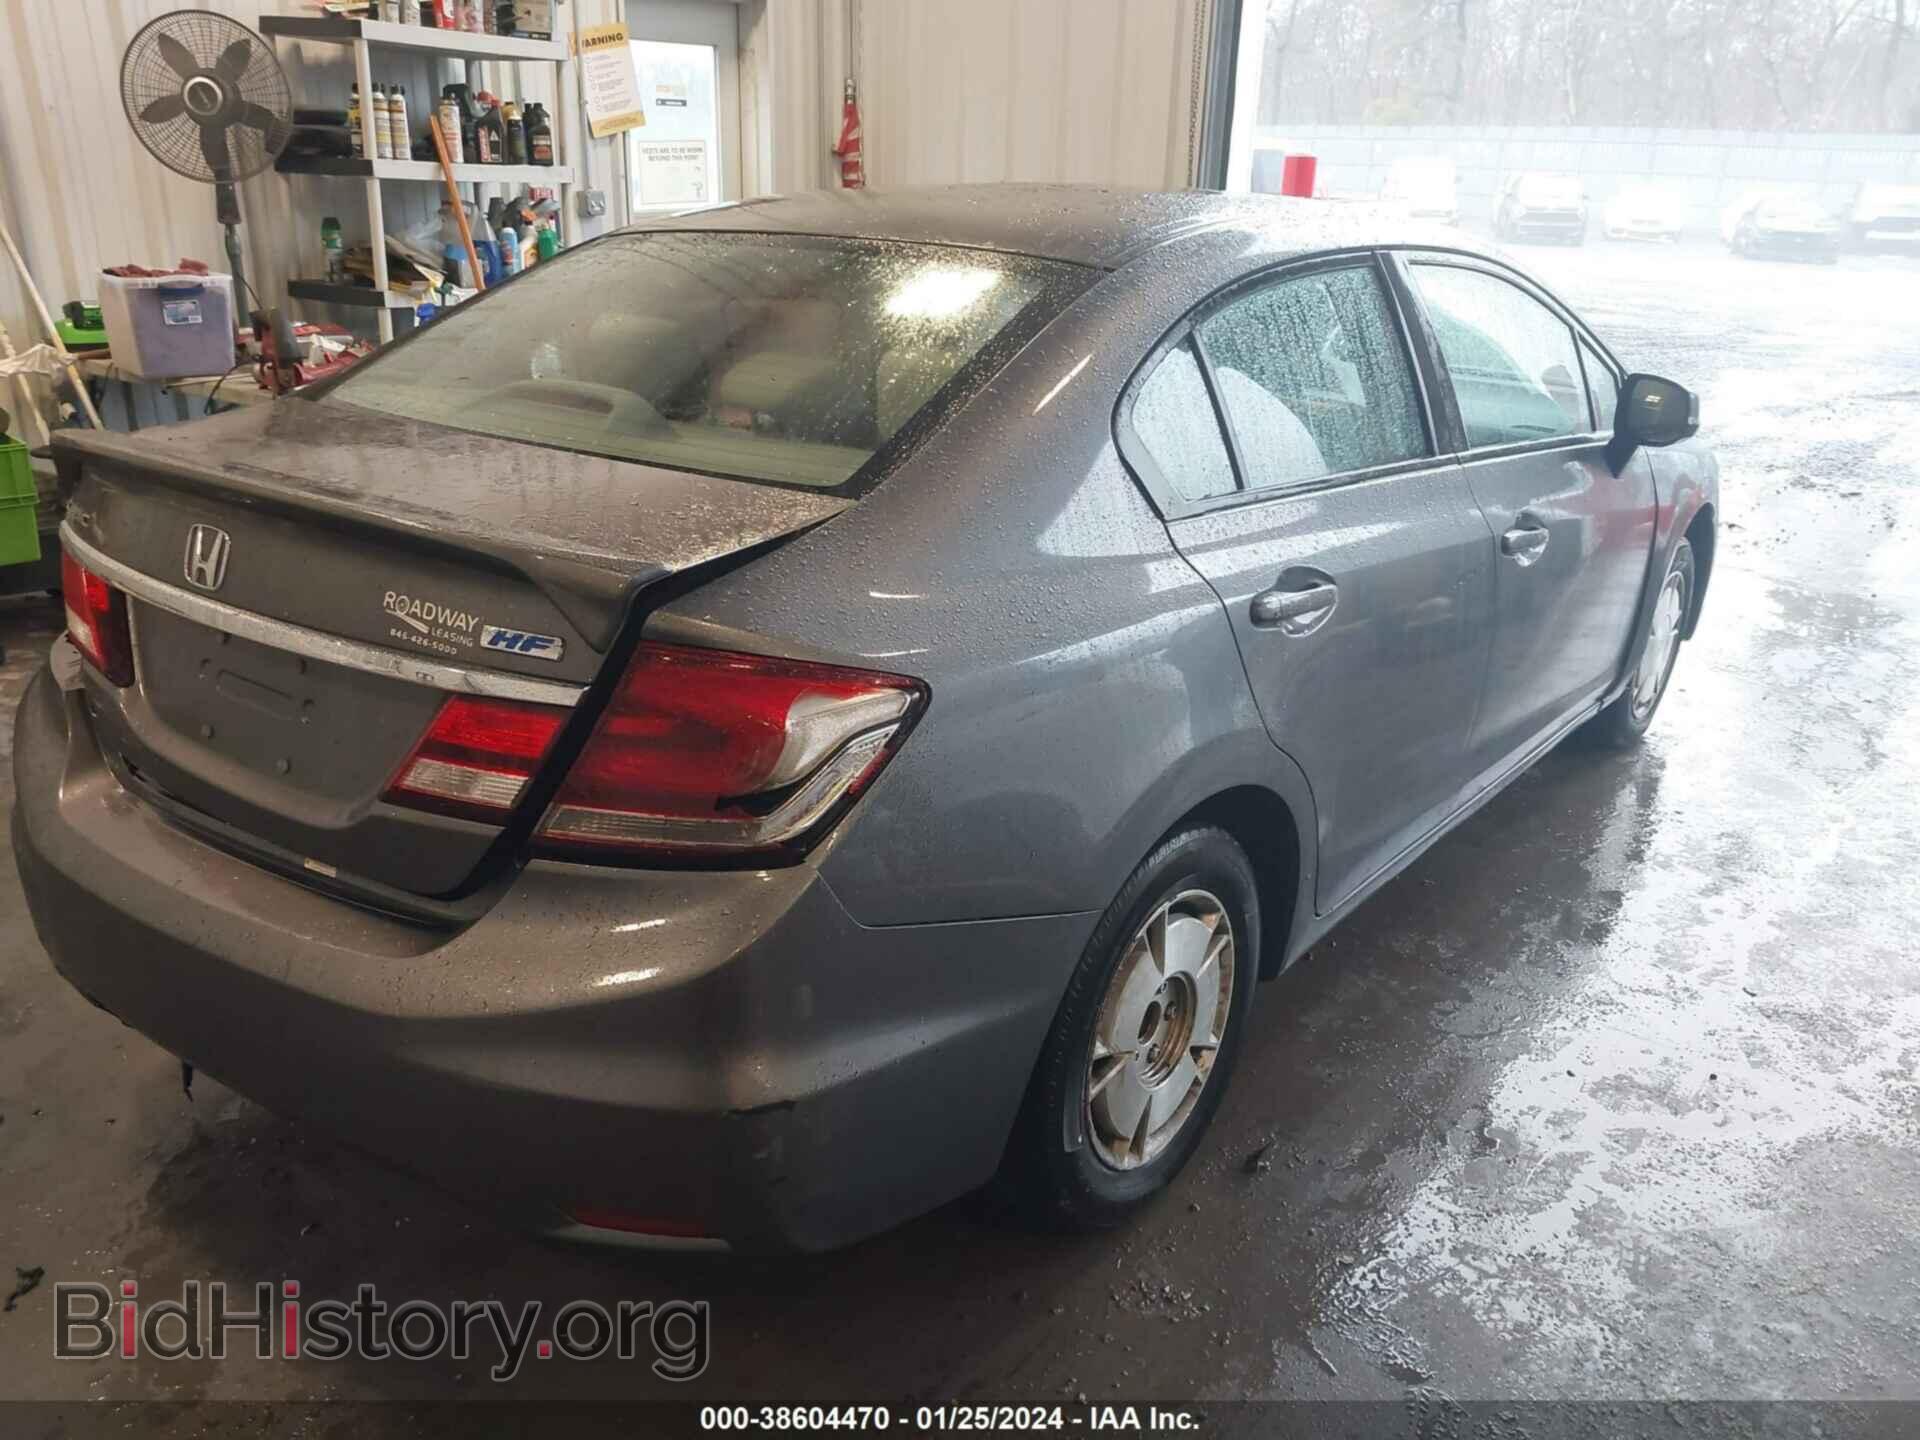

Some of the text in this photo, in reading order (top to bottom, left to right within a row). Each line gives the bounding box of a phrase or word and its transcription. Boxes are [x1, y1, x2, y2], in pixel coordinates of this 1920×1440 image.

[581, 32, 624, 48] ARNING
[383, 591, 479, 633] ROADWAY
[431, 627, 473, 648] LEASING
[488, 630, 556, 653] HF
